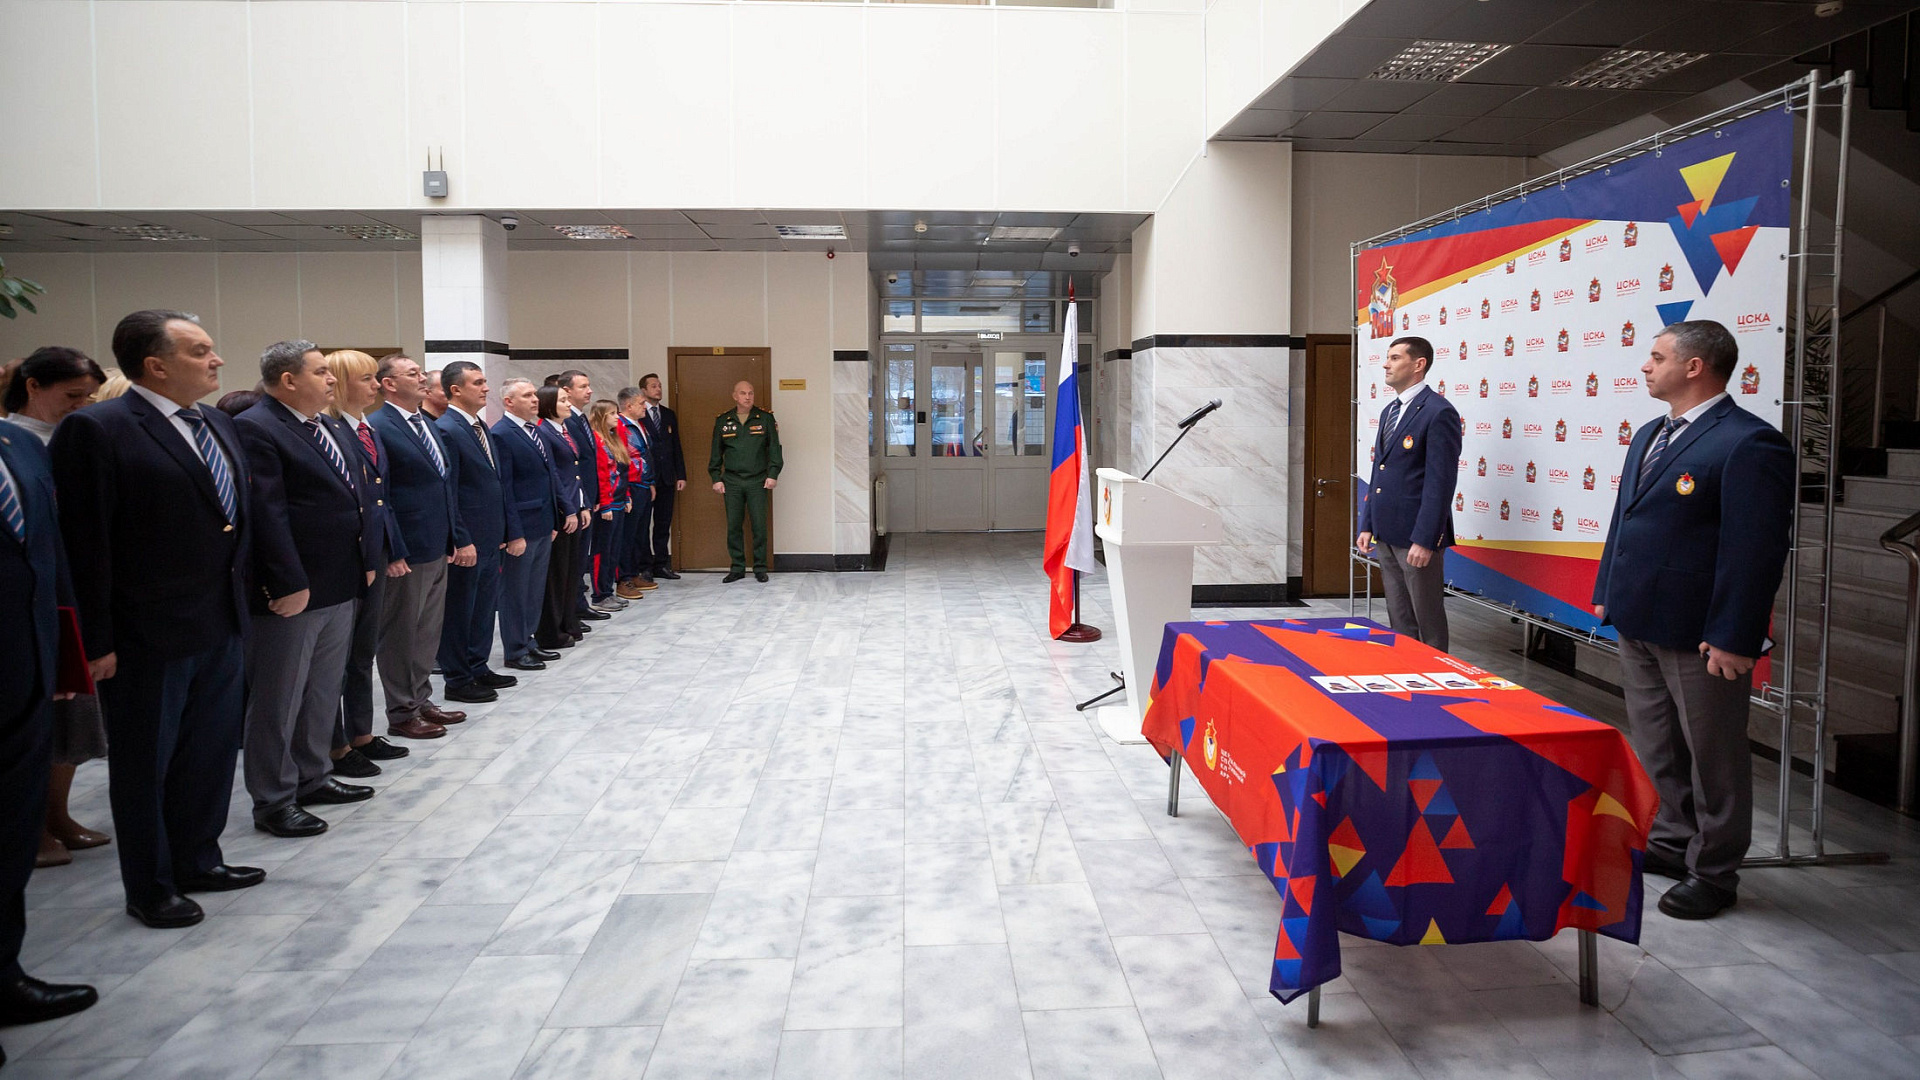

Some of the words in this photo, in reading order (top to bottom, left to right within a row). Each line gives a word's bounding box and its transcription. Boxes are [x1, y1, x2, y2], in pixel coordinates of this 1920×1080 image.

[1586, 235, 1608, 246] ЦСКА
[1528, 250, 1546, 260] ЦСКА
[1616, 279, 1640, 290] ЦСКА
[1554, 289, 1574, 299] ЦСКА
[1501, 299, 1518, 307] ЦСКА
[1456, 307, 1471, 315] ЦСКА
[1738, 313, 1770, 325] ЦСКА
[1583, 332, 1605, 340] ЦСКА
[1526, 338, 1545, 346] ЦСКА
[1614, 378, 1637, 386] ЦСКА
[1497, 464, 1514, 472] ЦСКА
[1549, 469, 1569, 478] ЦСКА
[1611, 475, 1621, 483] ЦС
[1474, 500, 1489, 508] ЦСКА
[1522, 508, 1540, 517] ЦСКА
[1578, 518, 1599, 528] ЦСКА
